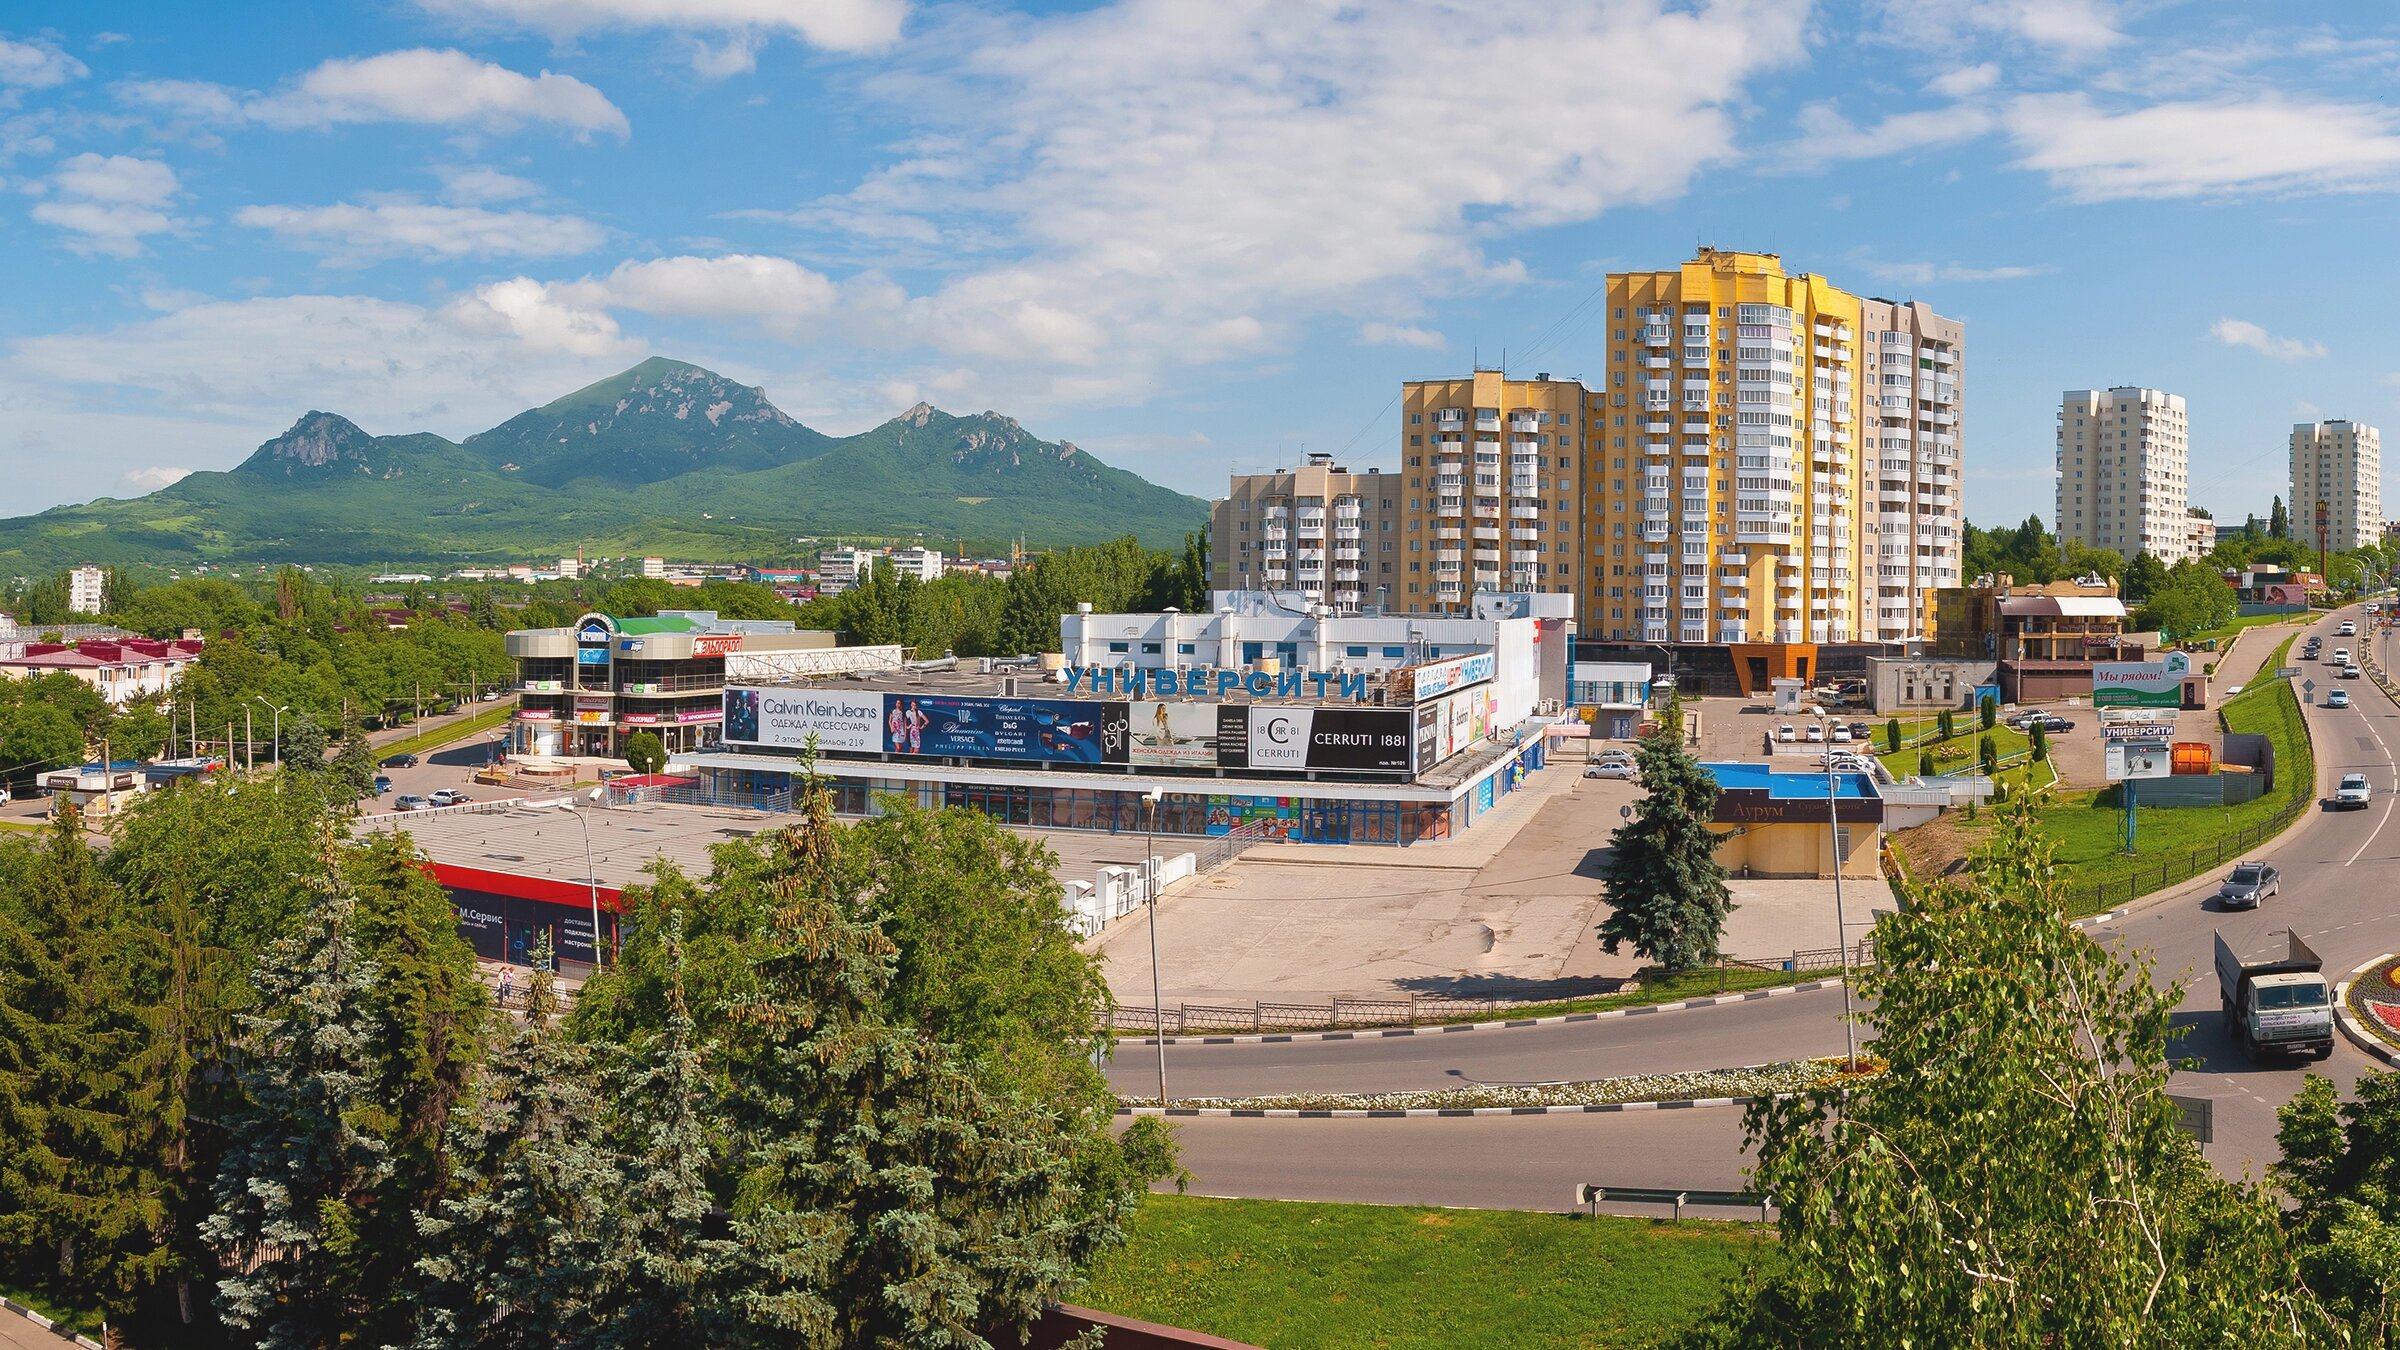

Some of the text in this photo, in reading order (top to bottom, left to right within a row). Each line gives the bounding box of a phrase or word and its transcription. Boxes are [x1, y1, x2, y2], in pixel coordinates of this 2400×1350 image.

[2097, 669, 2163, 683] Мы рядом!
[1064, 667, 1367, 699] УНИВЕРСИТИ
[763, 698, 877, 719] Calvin Klein Jeans
[770, 718, 870, 732] ОДЕЖДА АКСЕССУАРЫ
[941, 721, 984, 735] Blumarine
[1003, 722, 1018, 730] D&G
[1257, 726, 1266, 735] 18
[1290, 726, 1299, 736] 81
[2106, 727, 2173, 737] УНИВЕРСИТИ
[774, 735, 780, 743] 2
[848, 738, 865, 747] 219
[1314, 733, 1406, 747] CERRUTI 1881
[1257, 749, 1299, 758] CERRUTI
[1733, 802, 1784, 821] Аурум
[564, 918, 592, 927] доставим
[564, 929, 595, 938] подключи
